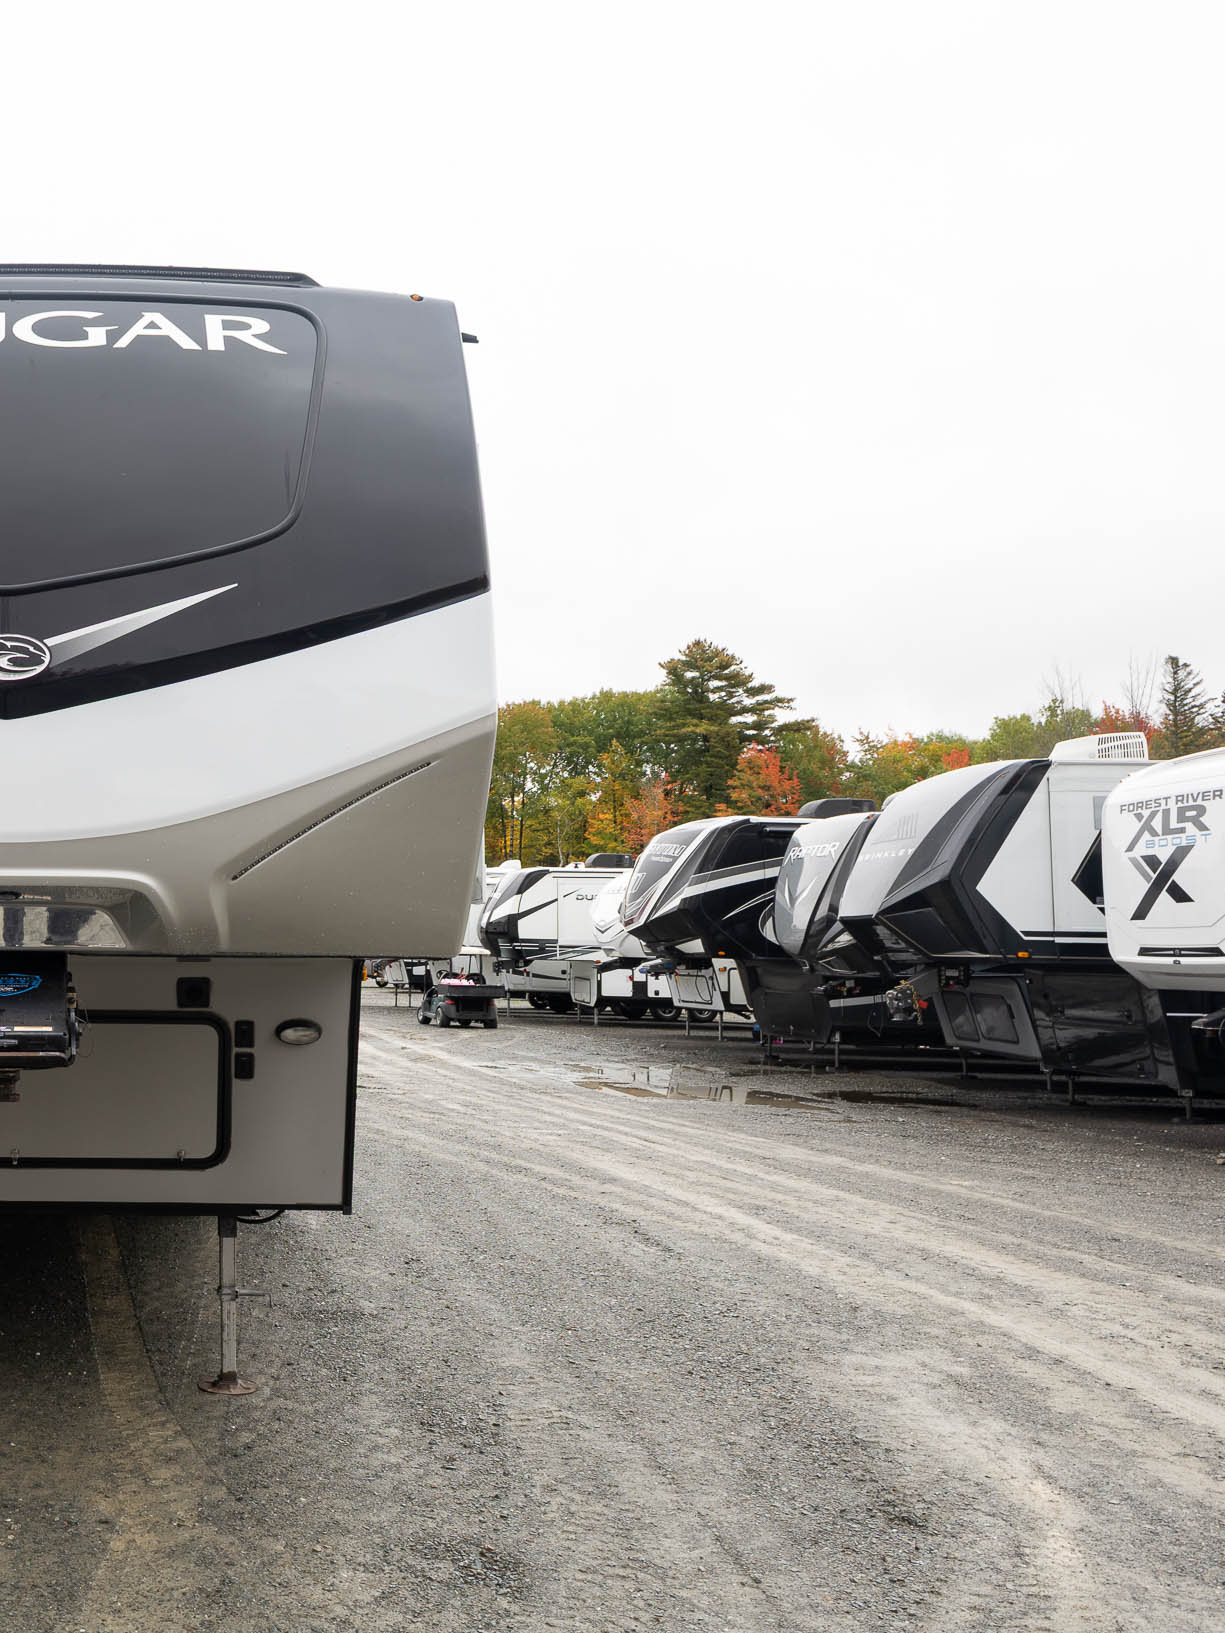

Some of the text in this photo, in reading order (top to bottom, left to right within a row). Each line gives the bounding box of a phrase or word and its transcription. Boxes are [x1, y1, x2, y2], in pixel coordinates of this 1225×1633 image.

[1119, 788, 1224, 815] FOREST RIVER
[1124, 803, 1211, 854] XLR
[1145, 832, 1213, 849] BOOST
[783, 842, 841, 866] RAPTOR
